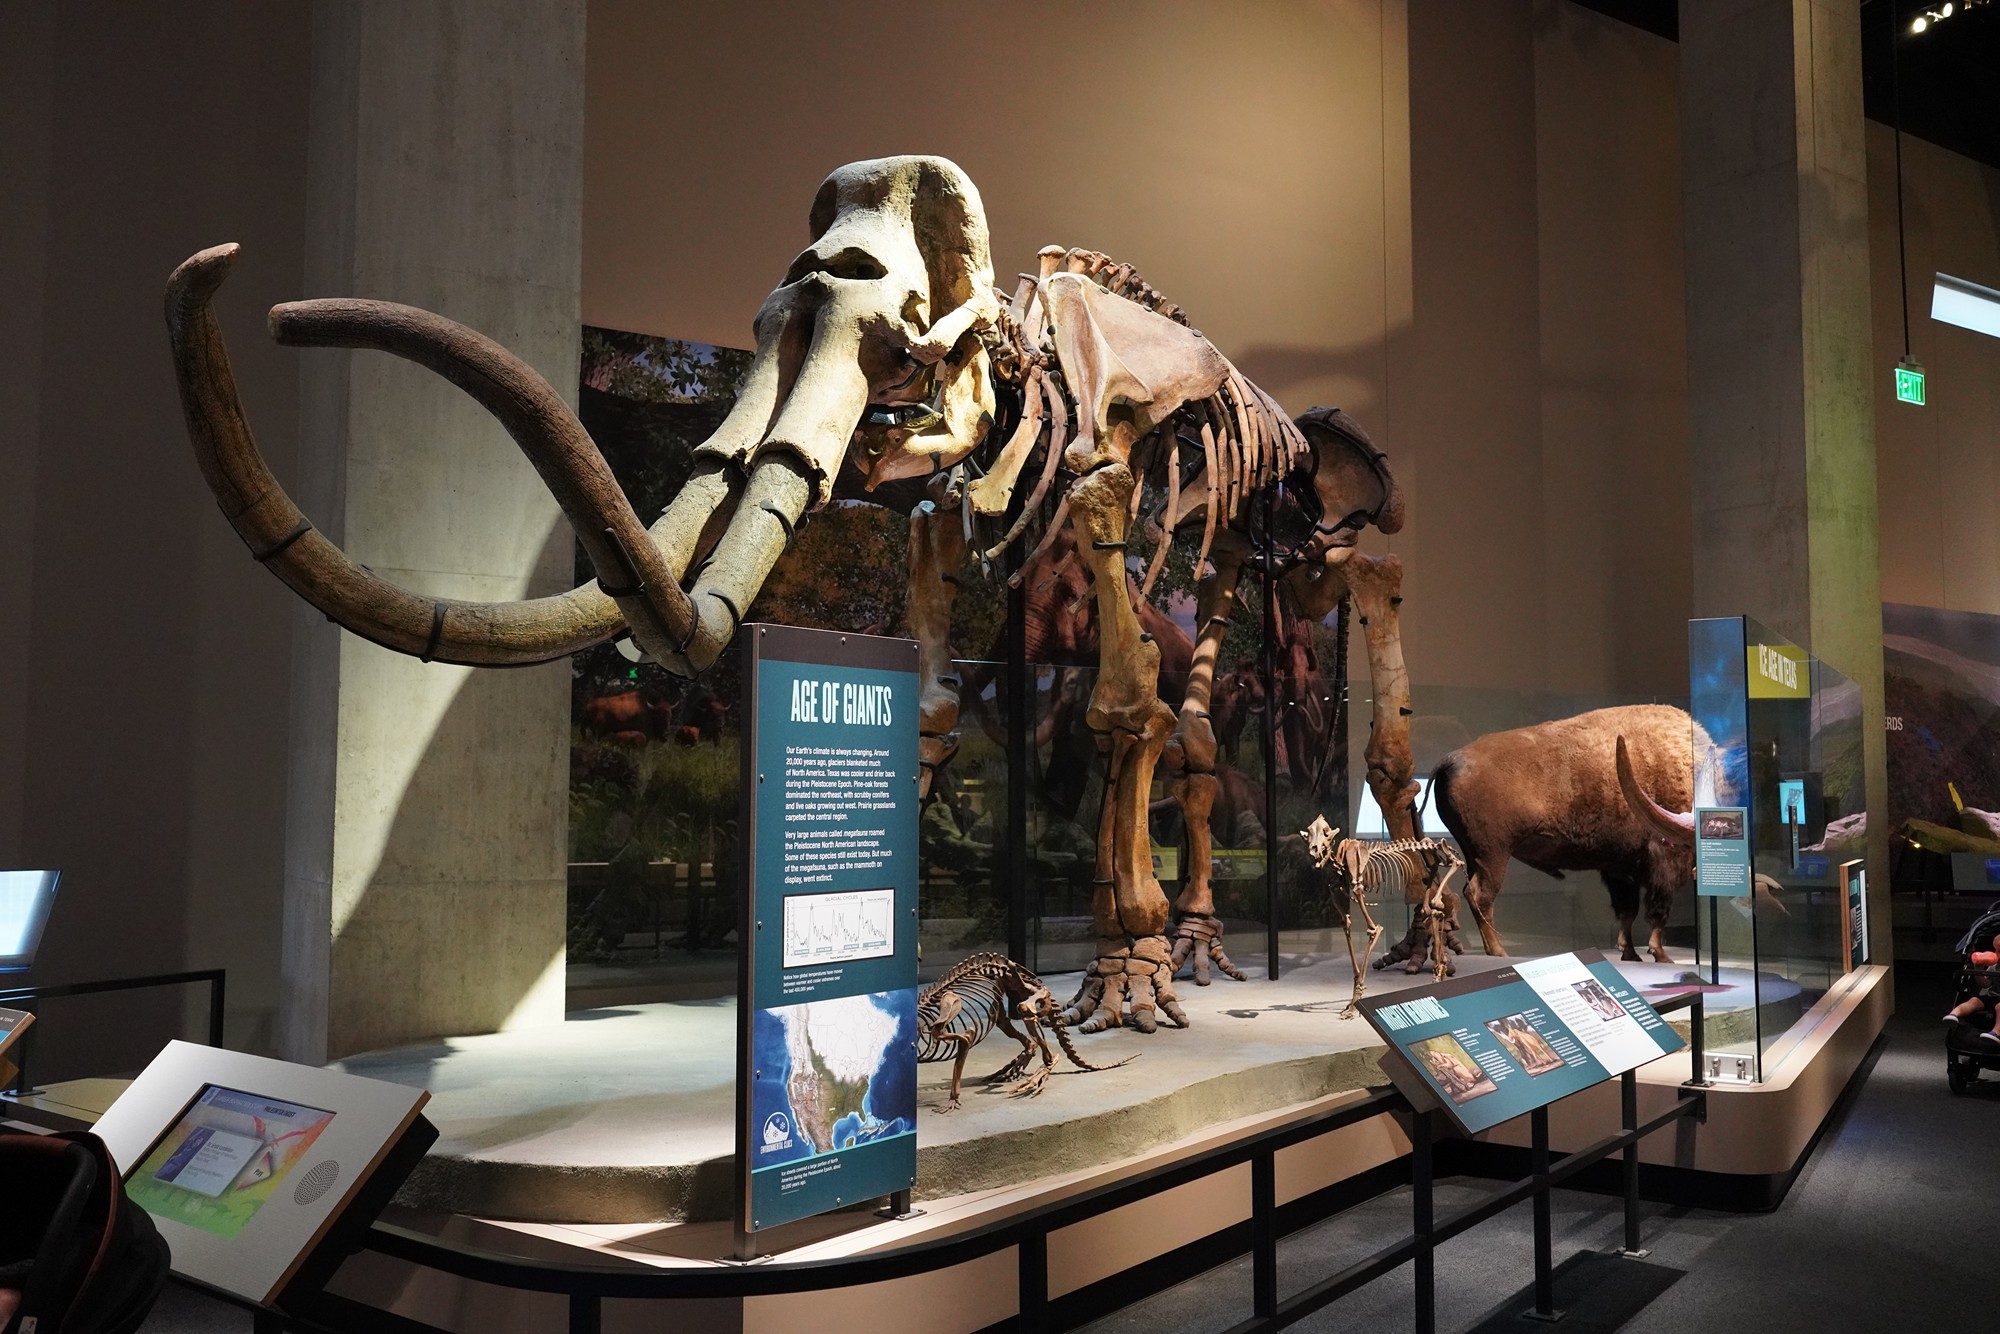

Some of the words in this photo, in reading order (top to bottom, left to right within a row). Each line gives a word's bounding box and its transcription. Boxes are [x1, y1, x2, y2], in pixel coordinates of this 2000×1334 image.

[1902, 373, 1922, 401] EXIT
[1759, 643, 1768, 677] ICE
[1769, 648, 1778, 681] AGE
[1778, 653, 1783, 684] IN
[1783, 656, 1797, 690] TEXAS
[791, 680, 818, 723] AGE
[822, 682, 840, 724] OF
[844, 684, 892, 726] GIANTS
[813, 747, 830, 755] climate
[836, 748, 851, 756] always
[852, 749, 873, 757] changing.
[828, 759, 845, 767] glaciers
[873, 802, 895, 810] grasslands
[786, 814, 806, 822] carpeted
[833, 813, 848, 821] region.
[785, 831, 796, 840] Very
[797, 831, 809, 839] large
[844, 830, 868, 838] megafauna
[858, 851, 871, 859] today.
[800, 864, 827, 872] megafauna,
[785, 876, 802, 884] display,
[816, 874, 833, 882] extinct.
[1375, 1004, 1414, 1031] MIGHTY
